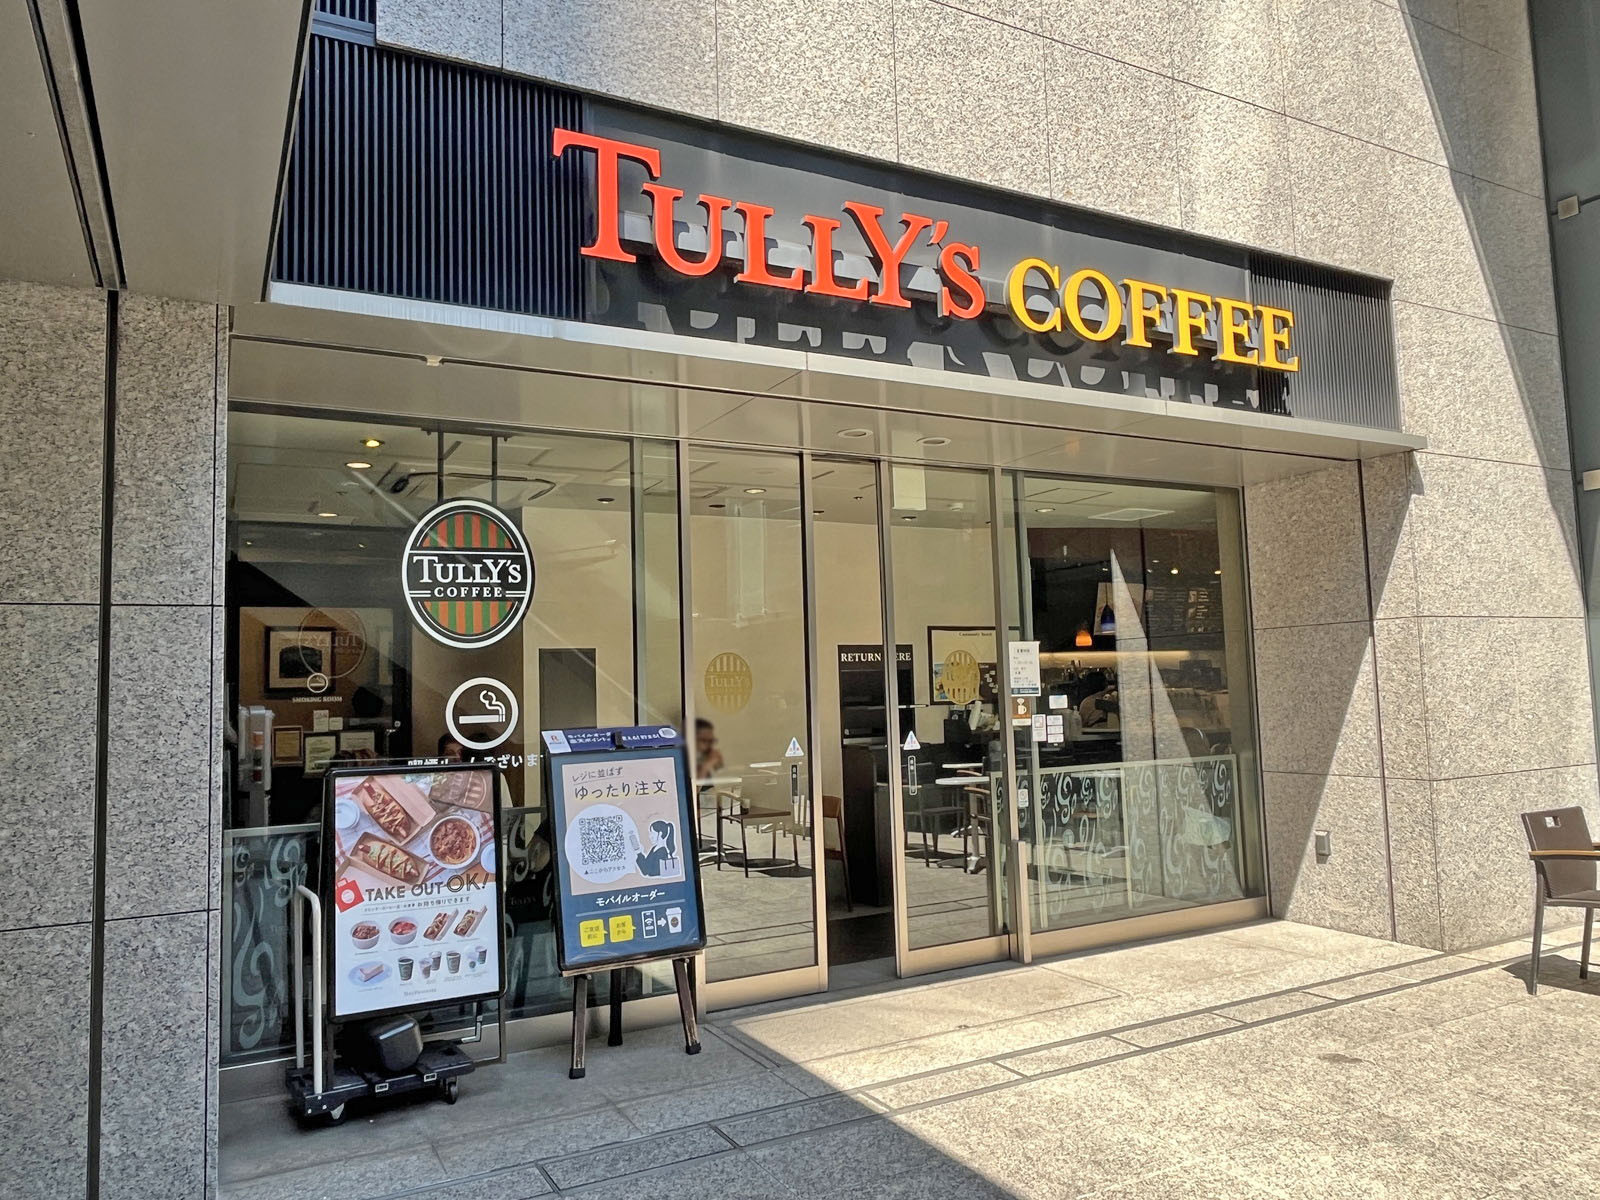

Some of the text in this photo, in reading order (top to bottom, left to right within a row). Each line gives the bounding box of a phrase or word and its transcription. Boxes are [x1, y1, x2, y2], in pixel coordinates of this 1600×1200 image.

[552, 127, 1300, 372] TULLY'S COFFEE
[412, 555, 522, 583] TULLY'S
[433, 586, 503, 598] COFFEE
[840, 652, 882, 662] RETURN
[572, 766, 624, 782] レジに並ばず
[574, 779, 668, 800] ゆったり注文
[365, 872, 490, 902] TAKE OUT OK!
[417, 896, 470, 907] お持ち帰りできます
[595, 888, 666, 907] モバイルオーダー
